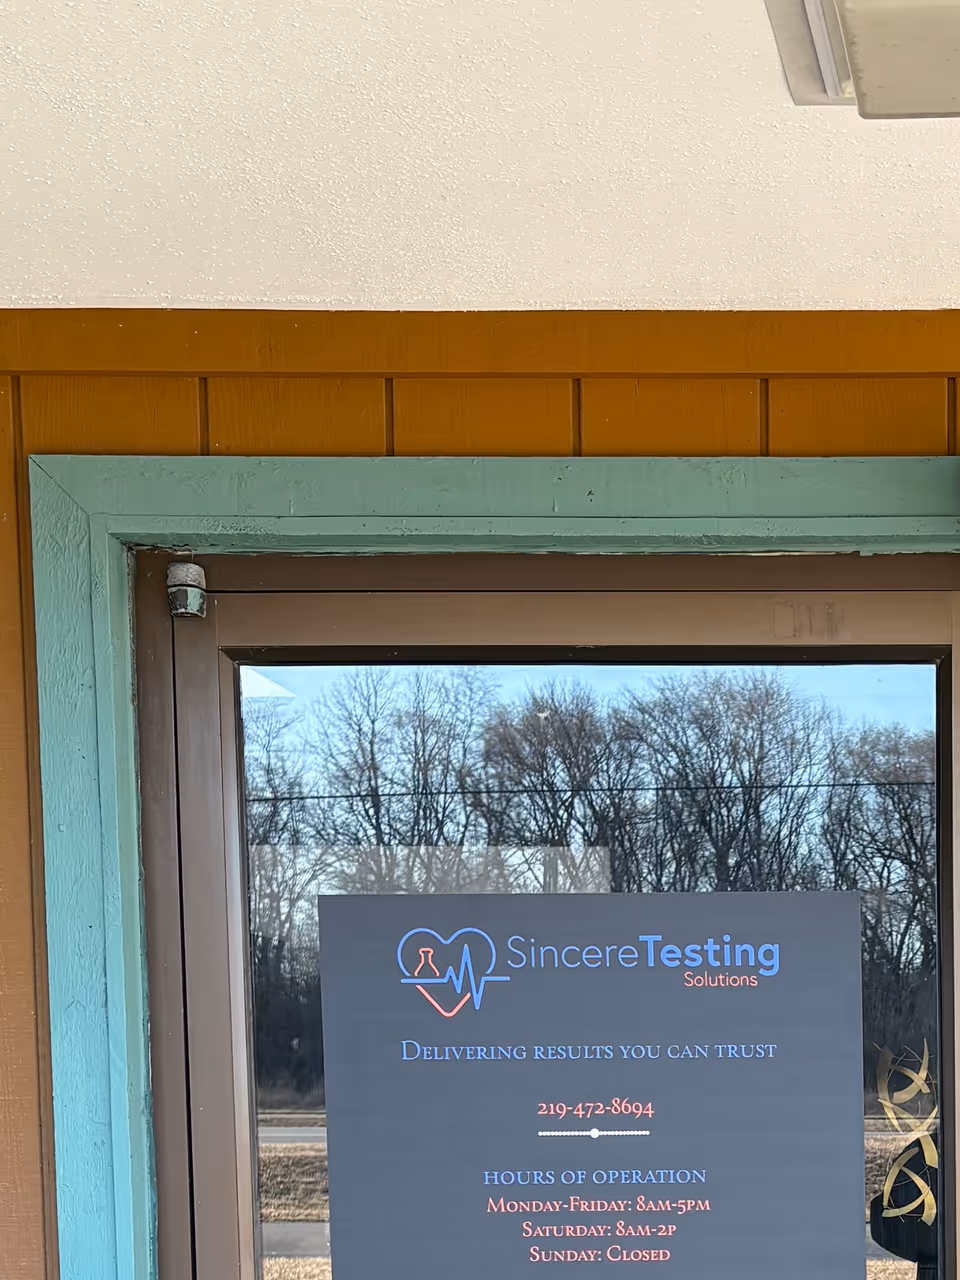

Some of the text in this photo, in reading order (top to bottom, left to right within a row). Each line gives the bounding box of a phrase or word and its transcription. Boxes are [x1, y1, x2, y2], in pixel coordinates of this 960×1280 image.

[684, 971, 759, 988] Solutions
[400, 1040, 778, 1062] DELIVERING RESULTS YOU CAN TRUST
[536, 1097, 656, 1120] 219-472-8694
[483, 1168, 707, 1186] HOURS OF OPERATION
[486, 1195, 712, 1215] MONDAY-FRIDAY: 8AM-5PM
[521, 1219, 677, 1239] SATURDAY: 8AM-2P
[529, 1244, 672, 1264] SUNDAY: CLOSED
